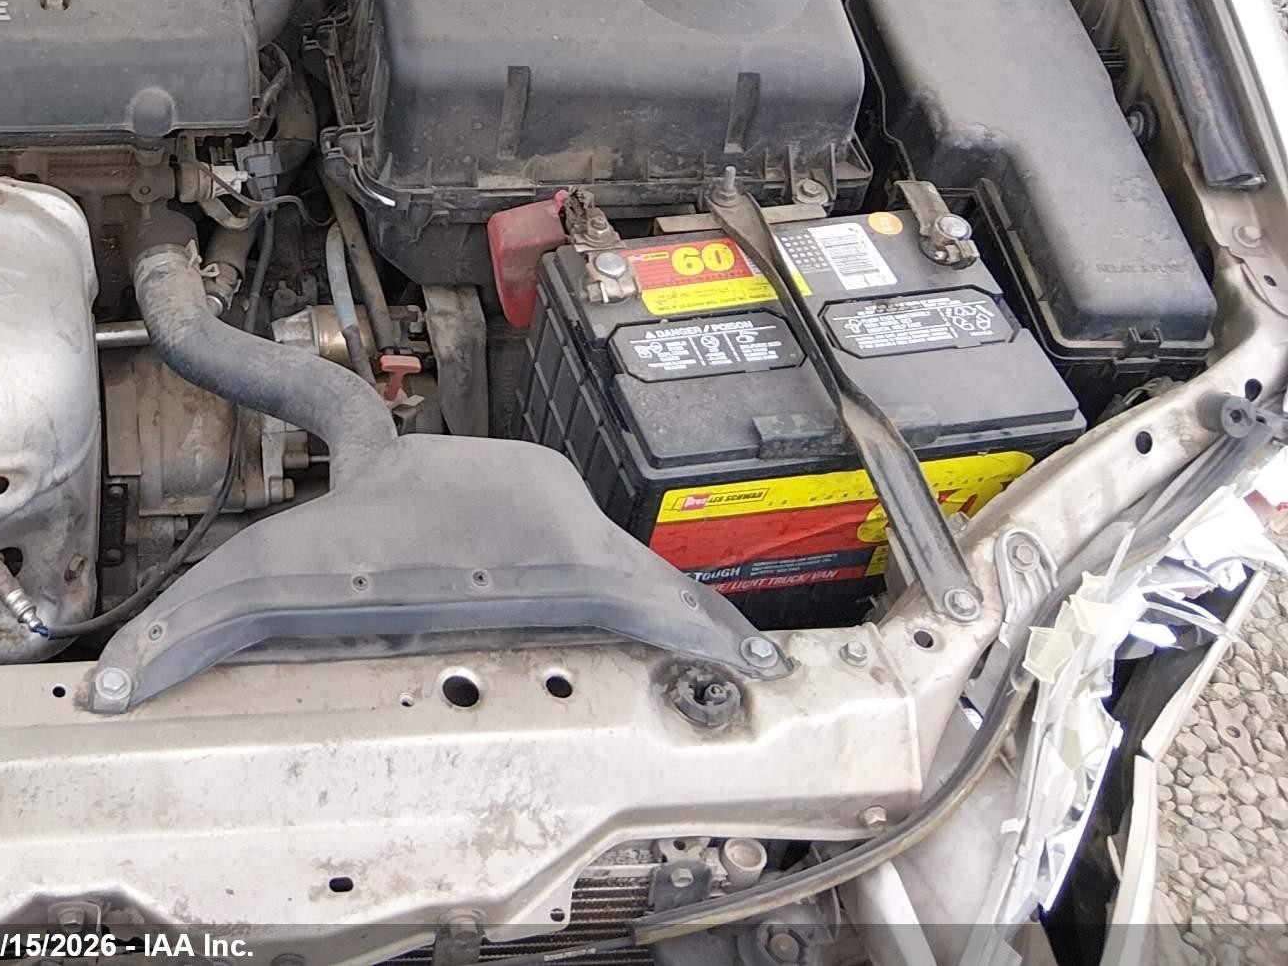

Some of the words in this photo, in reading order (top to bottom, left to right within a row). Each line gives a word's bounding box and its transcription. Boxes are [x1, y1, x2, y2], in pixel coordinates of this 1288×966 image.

[670, 241, 736, 276] 60
[655, 326, 702, 338] DANGER
[710, 320, 754, 332] POISON
[694, 566, 741, 581] TOUGH
